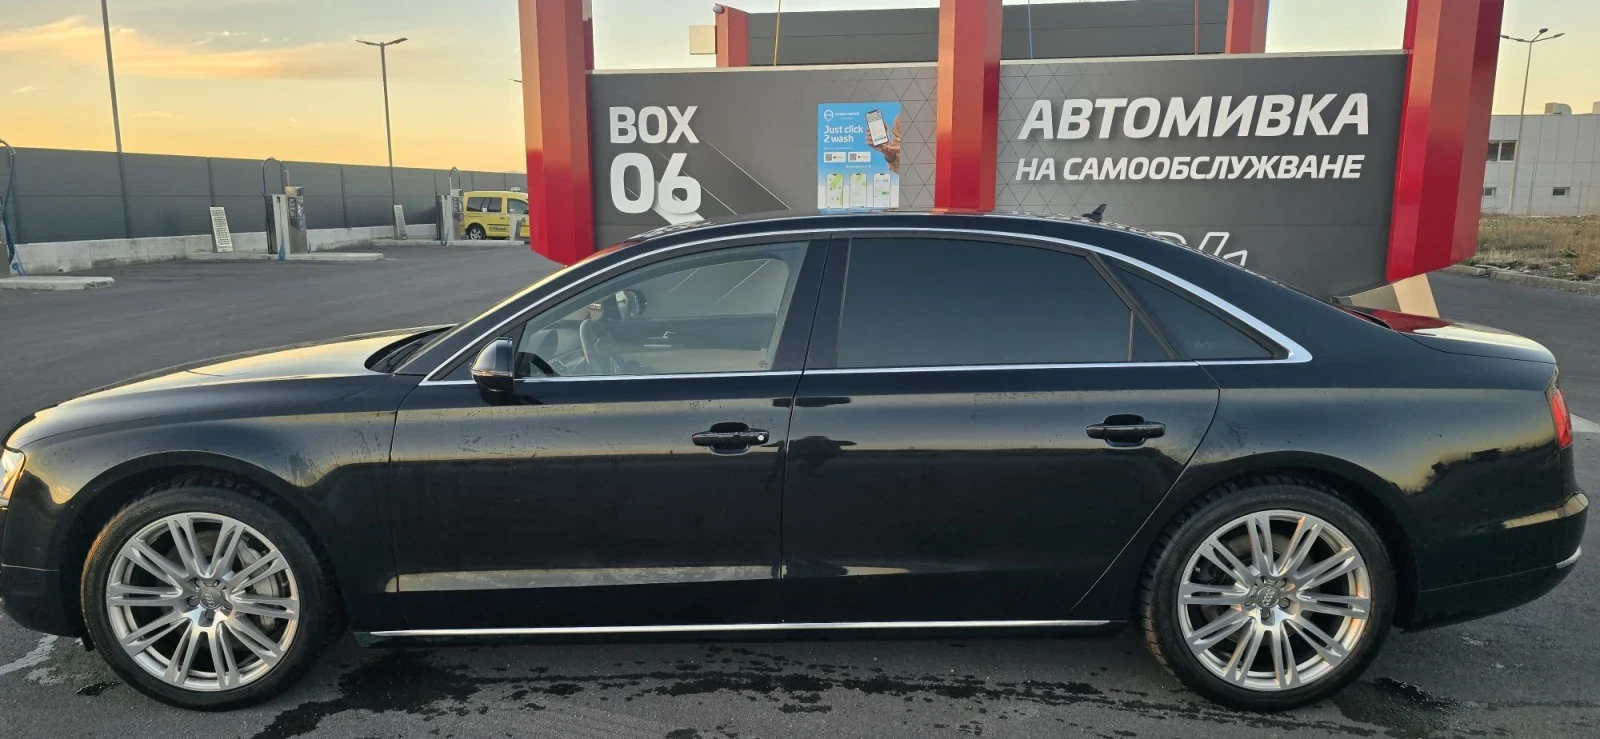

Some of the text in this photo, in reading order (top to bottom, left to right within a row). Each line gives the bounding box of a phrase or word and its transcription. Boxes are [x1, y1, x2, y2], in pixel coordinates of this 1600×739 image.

[609, 105, 700, 144] BOX
[824, 125, 864, 134] Just click
[1018, 92, 1369, 140] АВТОМИВКА
[824, 134, 854, 143] 2 wash
[610, 152, 702, 214] 06
[1015, 154, 1365, 181] НА САМООБСЛУЖВАНЕ
